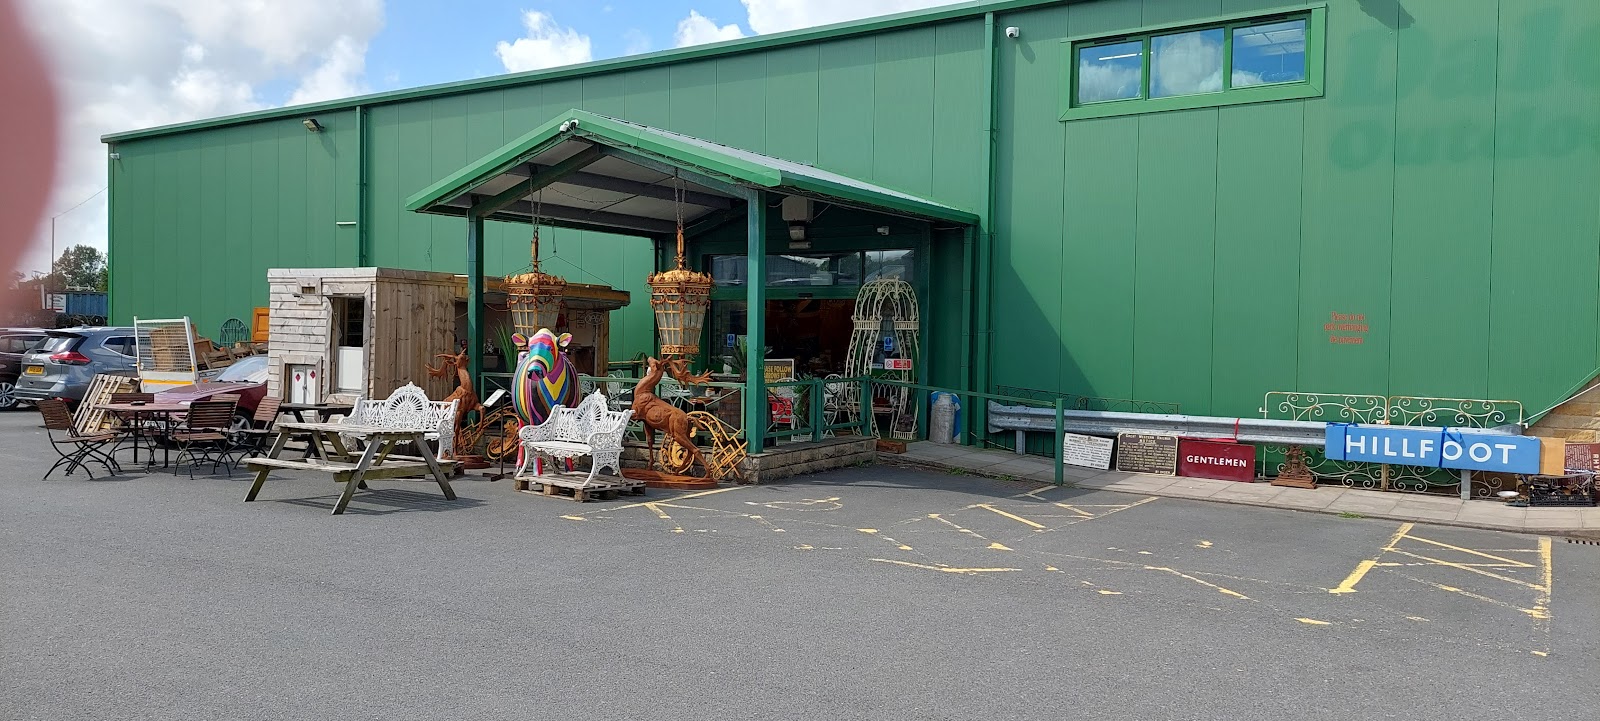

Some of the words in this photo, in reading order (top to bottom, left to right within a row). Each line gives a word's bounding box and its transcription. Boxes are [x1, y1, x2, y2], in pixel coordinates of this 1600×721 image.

[774, 365, 792, 373] FOLLOW
[1345, 434, 1517, 464] HILLFOOT
[1186, 454, 1247, 468] GENTLEMEN
